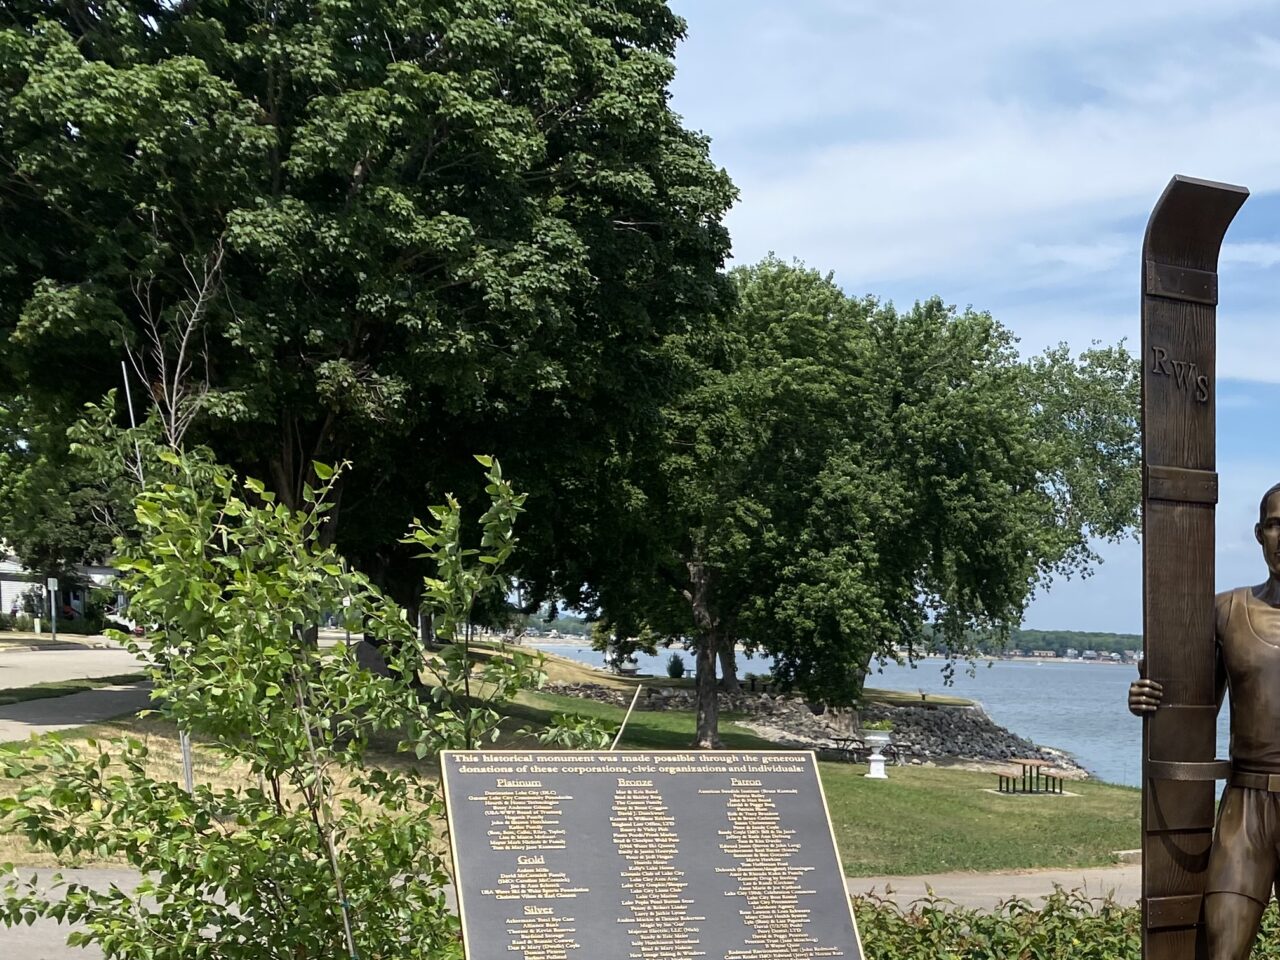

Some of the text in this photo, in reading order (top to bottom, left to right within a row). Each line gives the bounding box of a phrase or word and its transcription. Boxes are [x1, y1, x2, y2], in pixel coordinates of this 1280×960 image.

[1152, 346, 1208, 401] RWS
[654, 755, 695, 763] possible
[700, 755, 738, 763] through
[562, 765, 631, 774] corporations,
[659, 765, 726, 774] organizations
[497, 779, 542, 787] Platinum
[617, 778, 653, 786] Bronze
[731, 778, 762, 786] Patron
[518, 855, 545, 864] Gold
[524, 906, 554, 915] Silver
